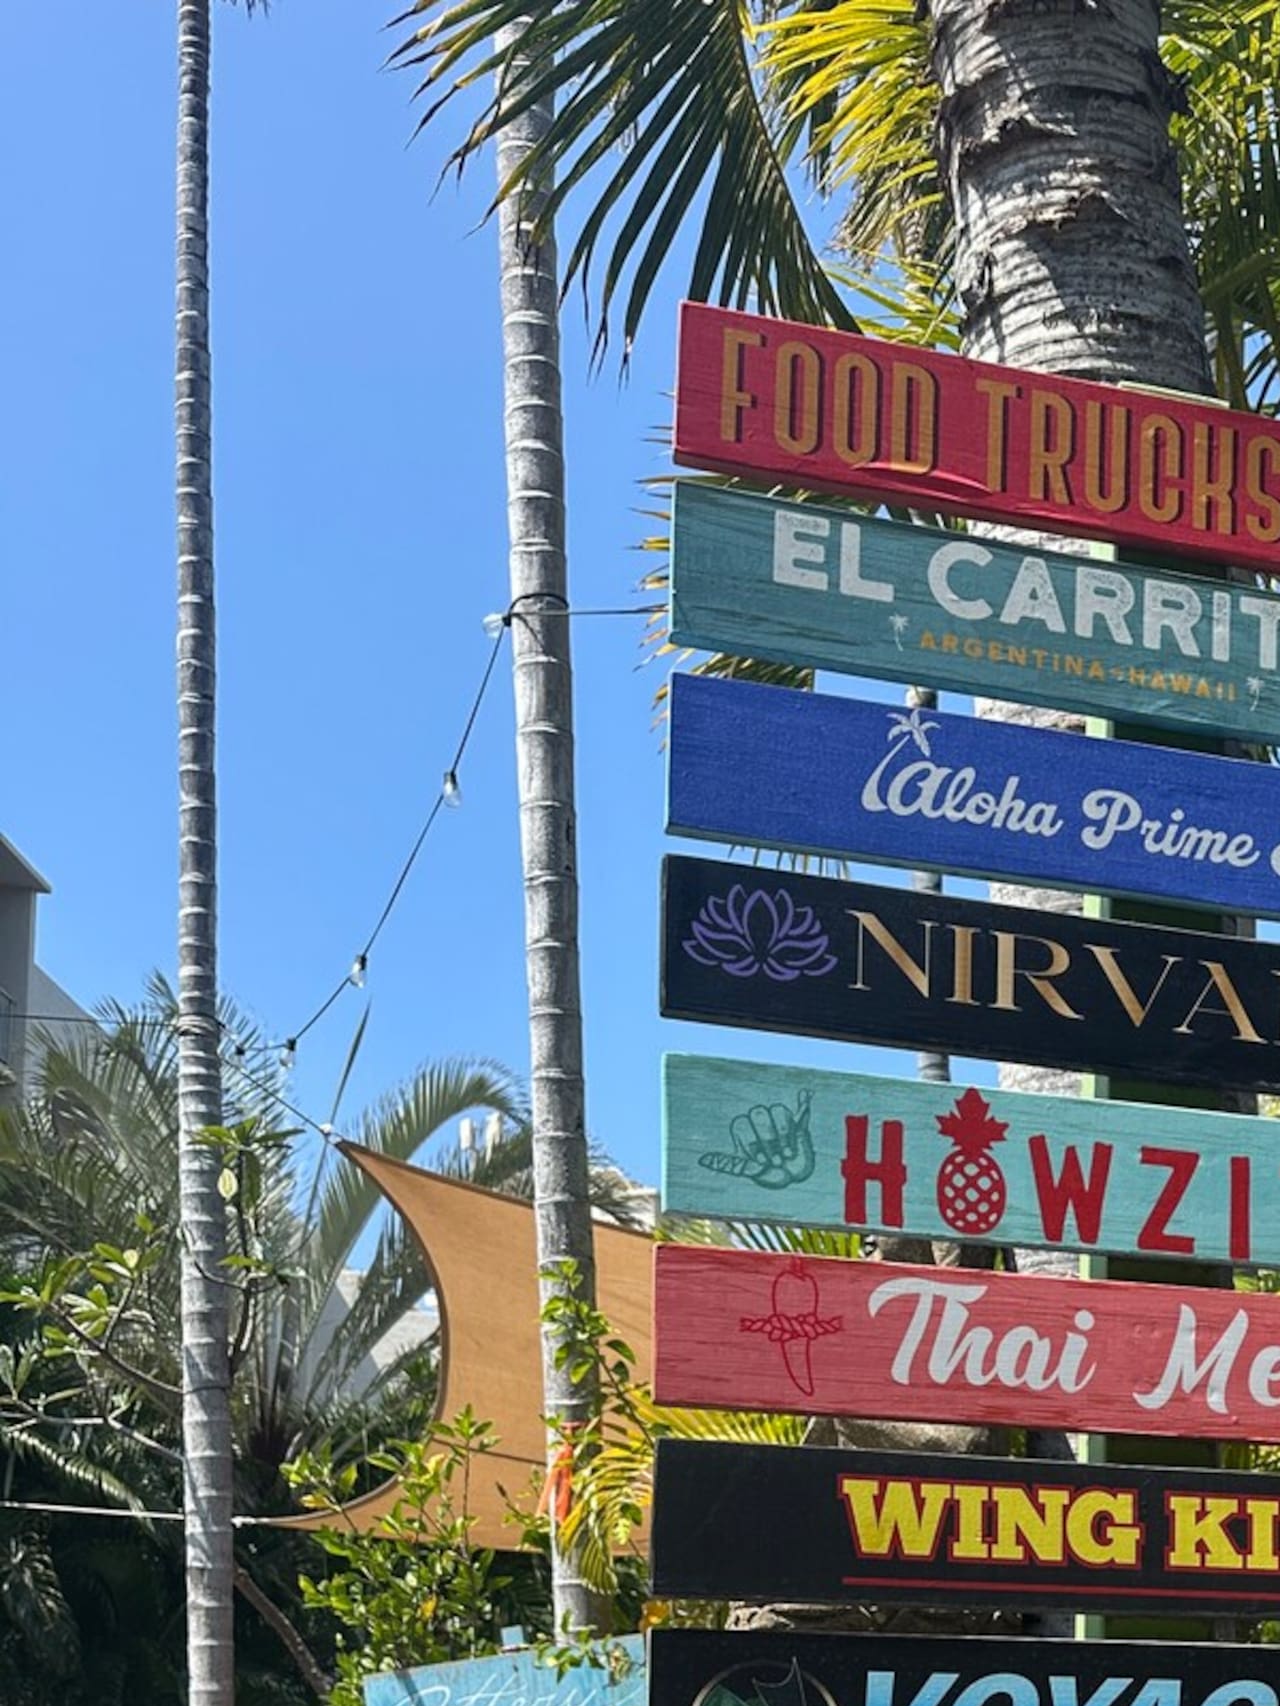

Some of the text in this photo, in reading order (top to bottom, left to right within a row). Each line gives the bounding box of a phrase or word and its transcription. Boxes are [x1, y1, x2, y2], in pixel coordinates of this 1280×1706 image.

[720, 327, 942, 478] FOOD
[772, 508, 895, 605] EL
[1080, 788, 1260, 868] Prime
[867, 1277, 1098, 1395] Thai
[837, 1473, 1146, 1572] WING
